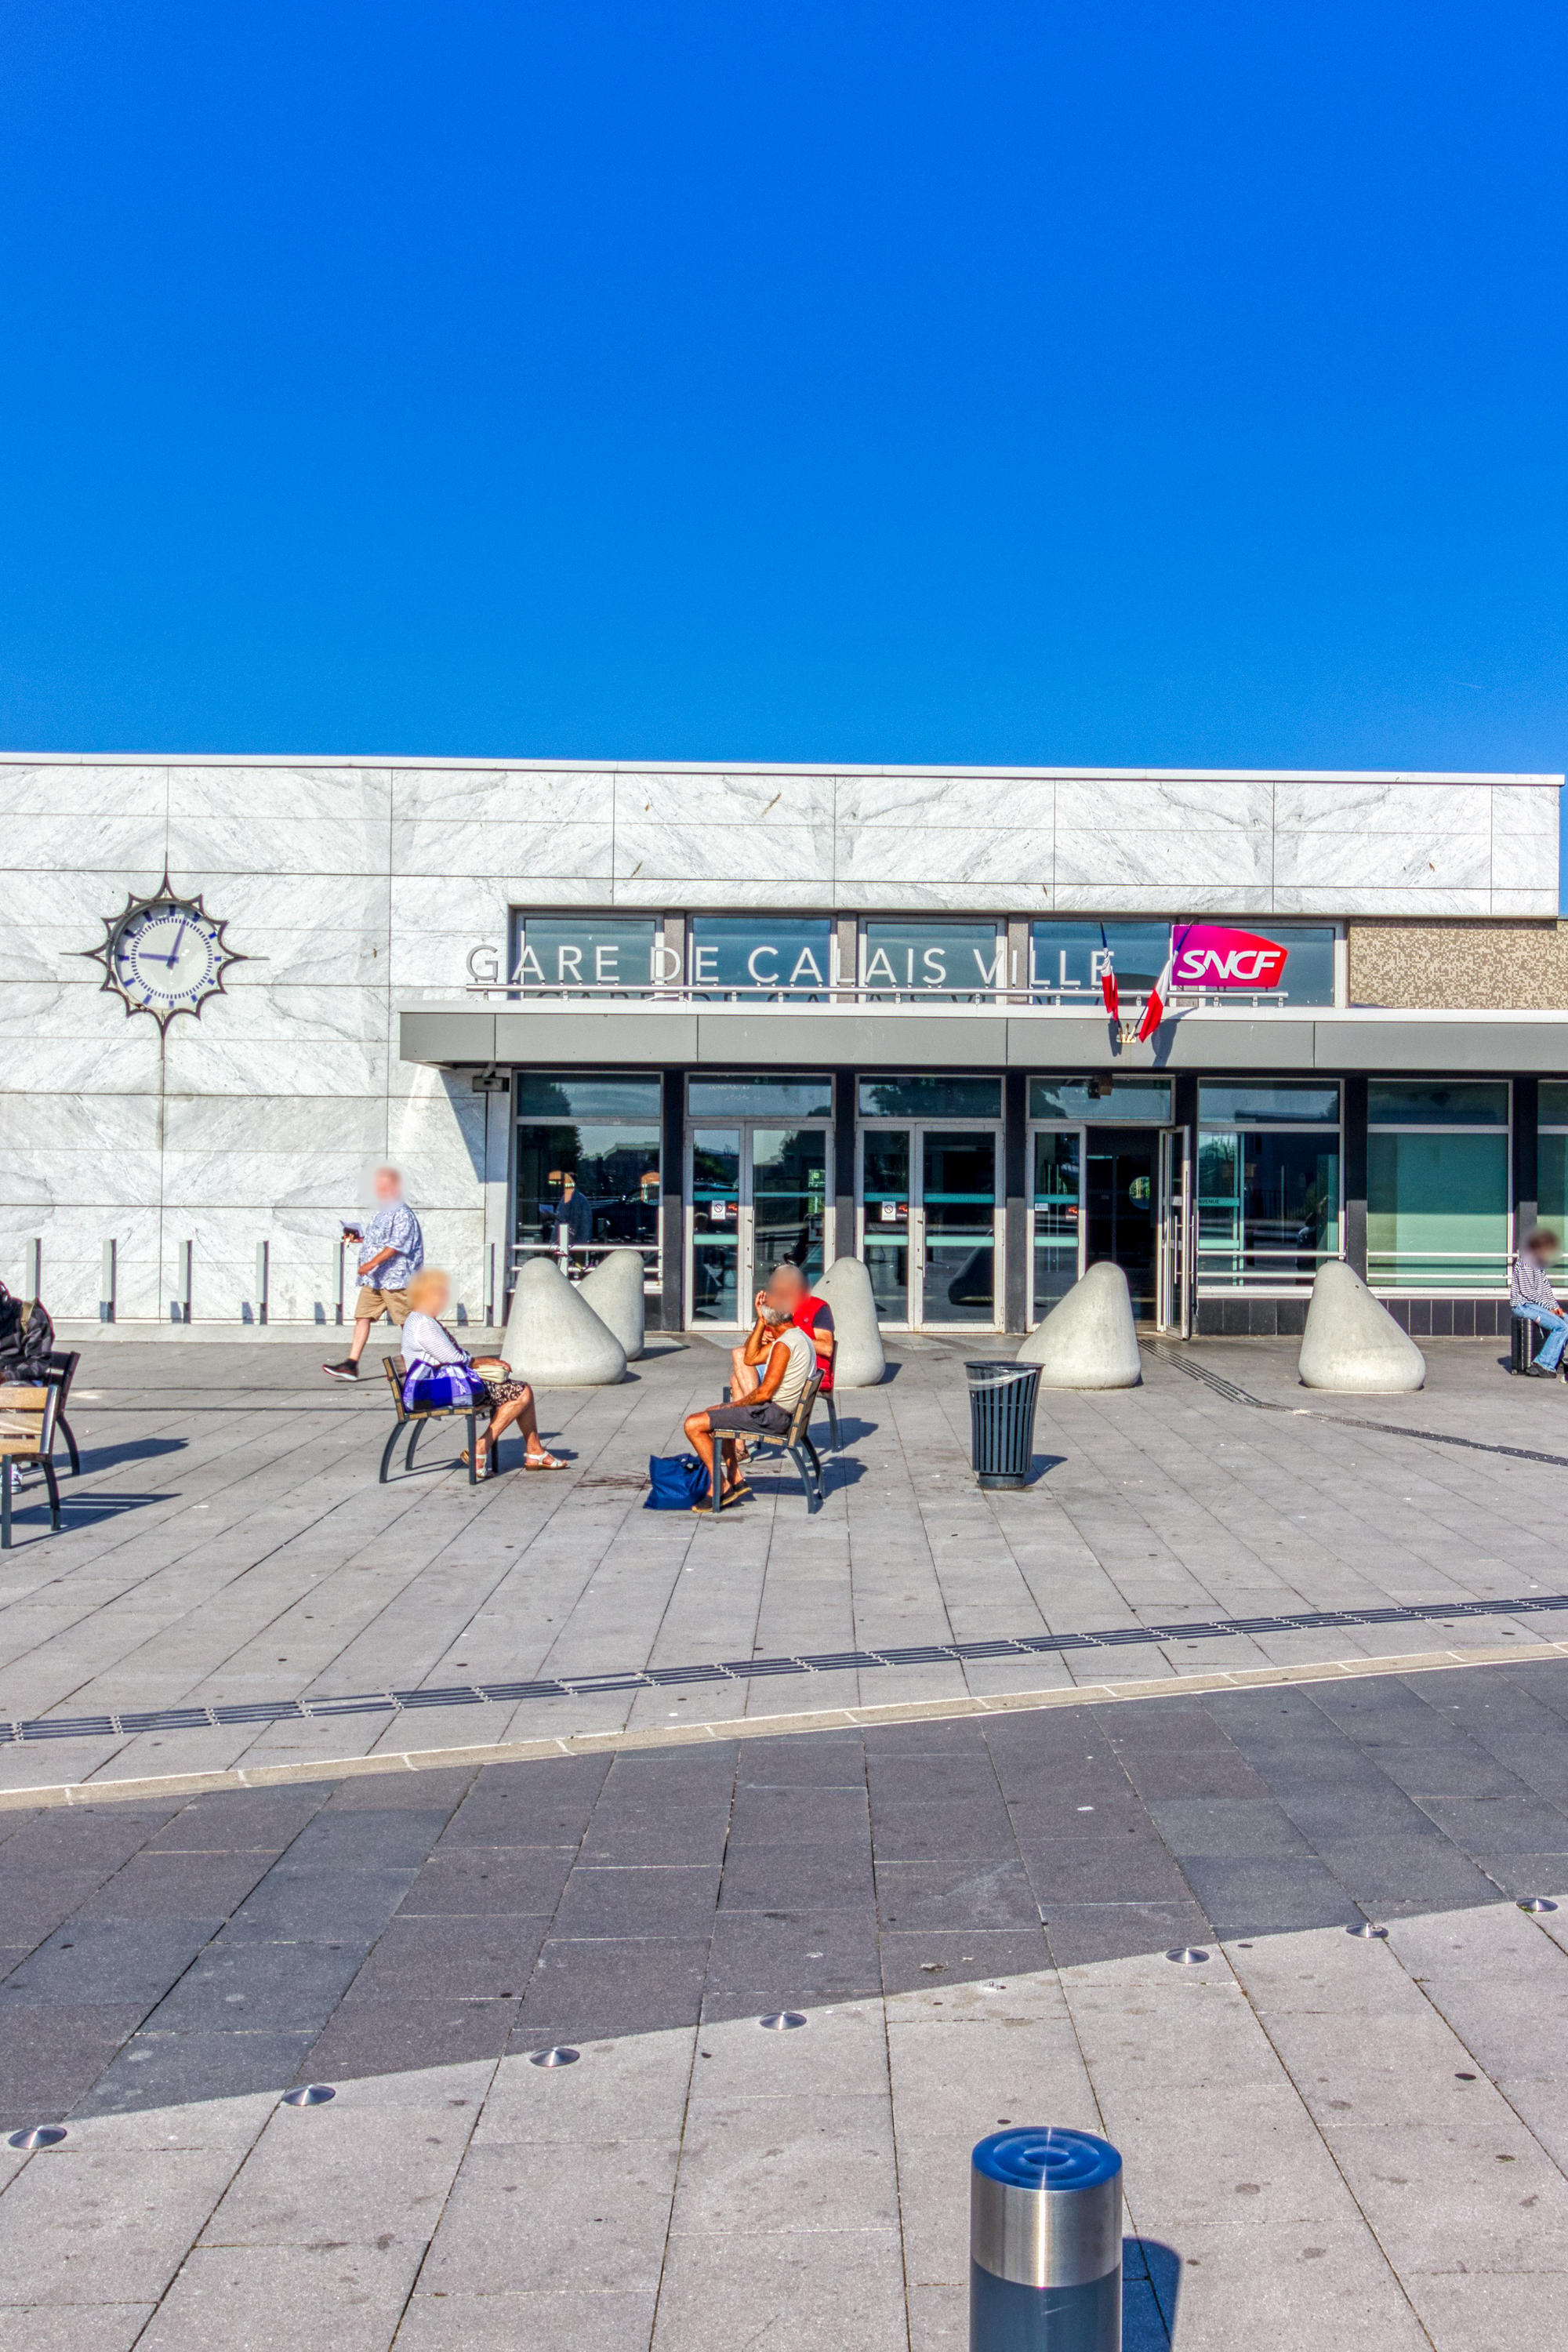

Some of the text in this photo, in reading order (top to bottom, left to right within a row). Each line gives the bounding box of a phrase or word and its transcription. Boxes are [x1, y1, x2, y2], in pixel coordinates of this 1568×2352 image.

[466, 945, 1115, 987] GARE DE CALAIS VILLE
[1177, 949, 1282, 980] SNCF
